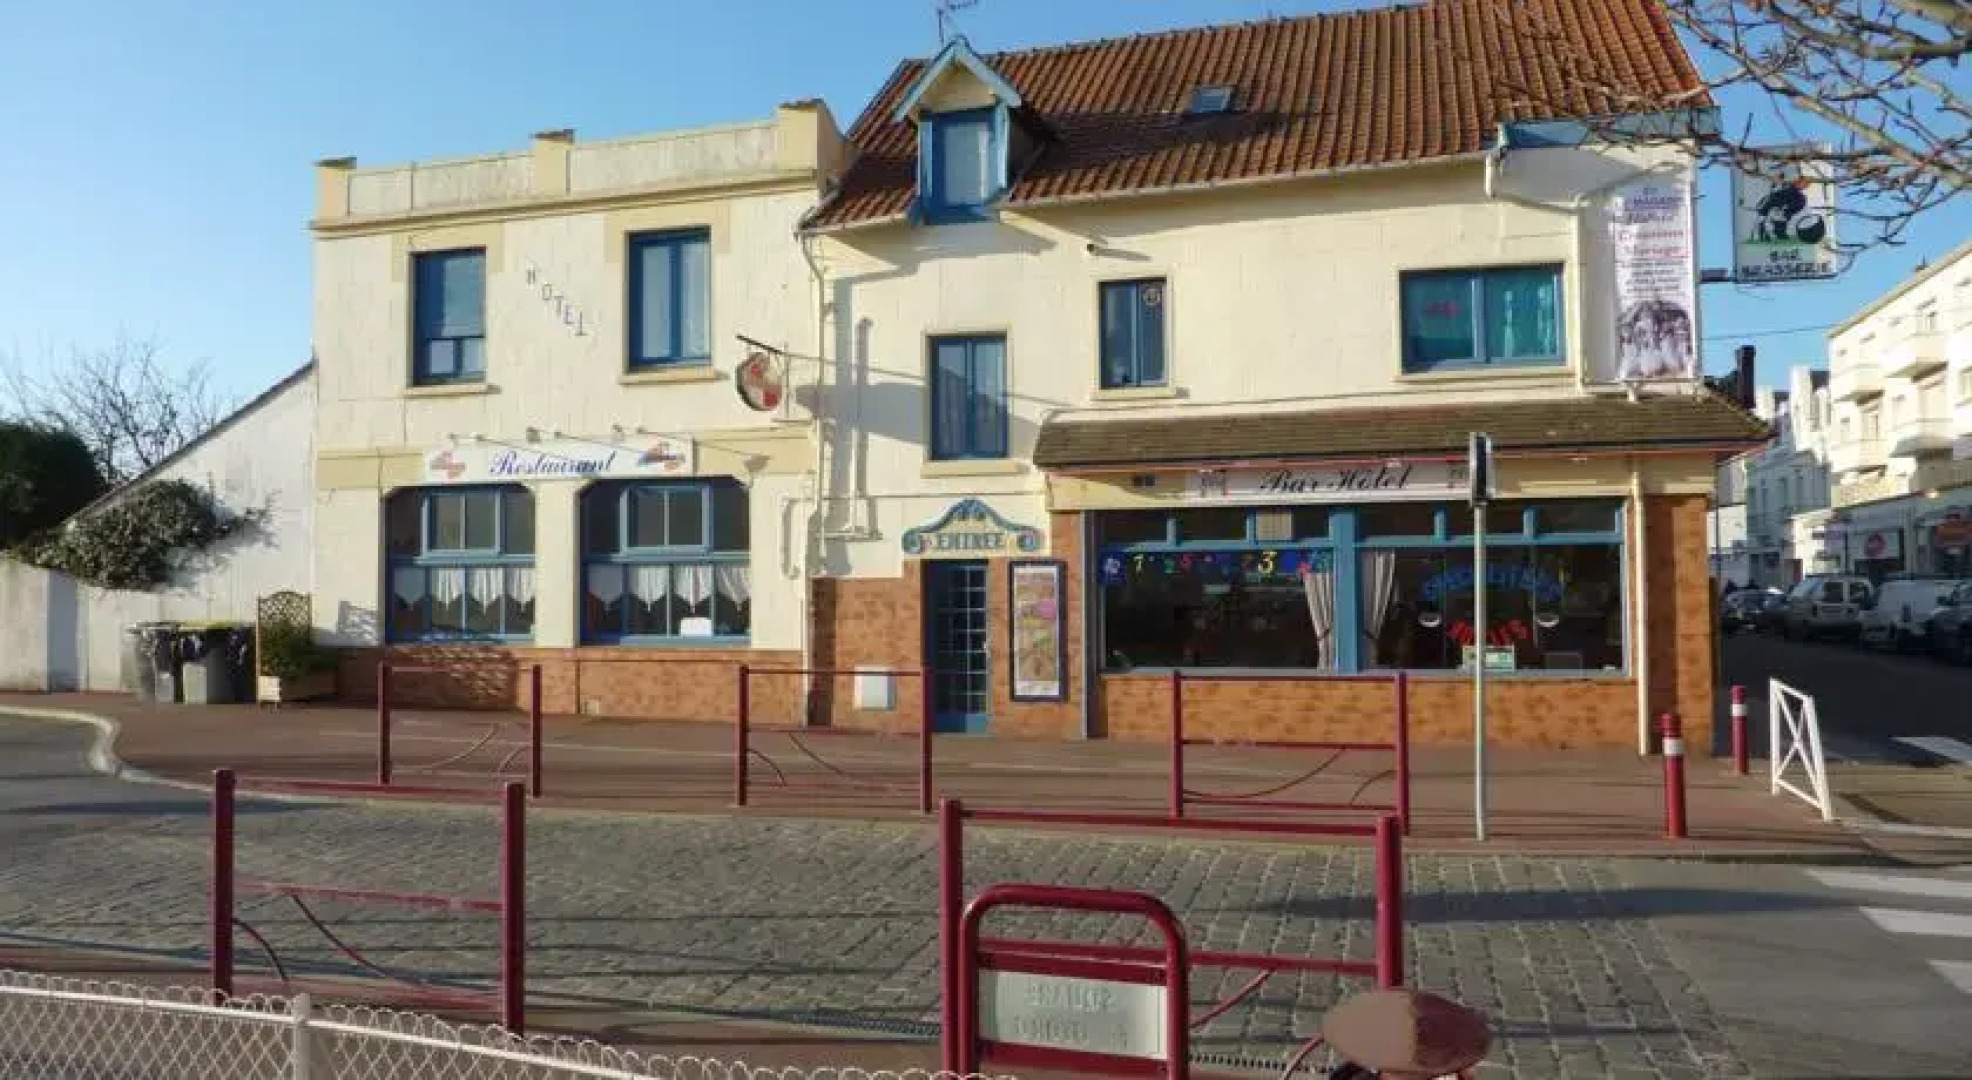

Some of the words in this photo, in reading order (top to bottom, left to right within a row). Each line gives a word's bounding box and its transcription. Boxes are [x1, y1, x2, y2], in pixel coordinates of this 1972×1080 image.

[1742, 263, 1832, 278] BRASSERIE
[526, 269, 589, 337] HOTEL
[489, 450, 617, 475] Restaurant
[1260, 469, 1318, 493] Bar
